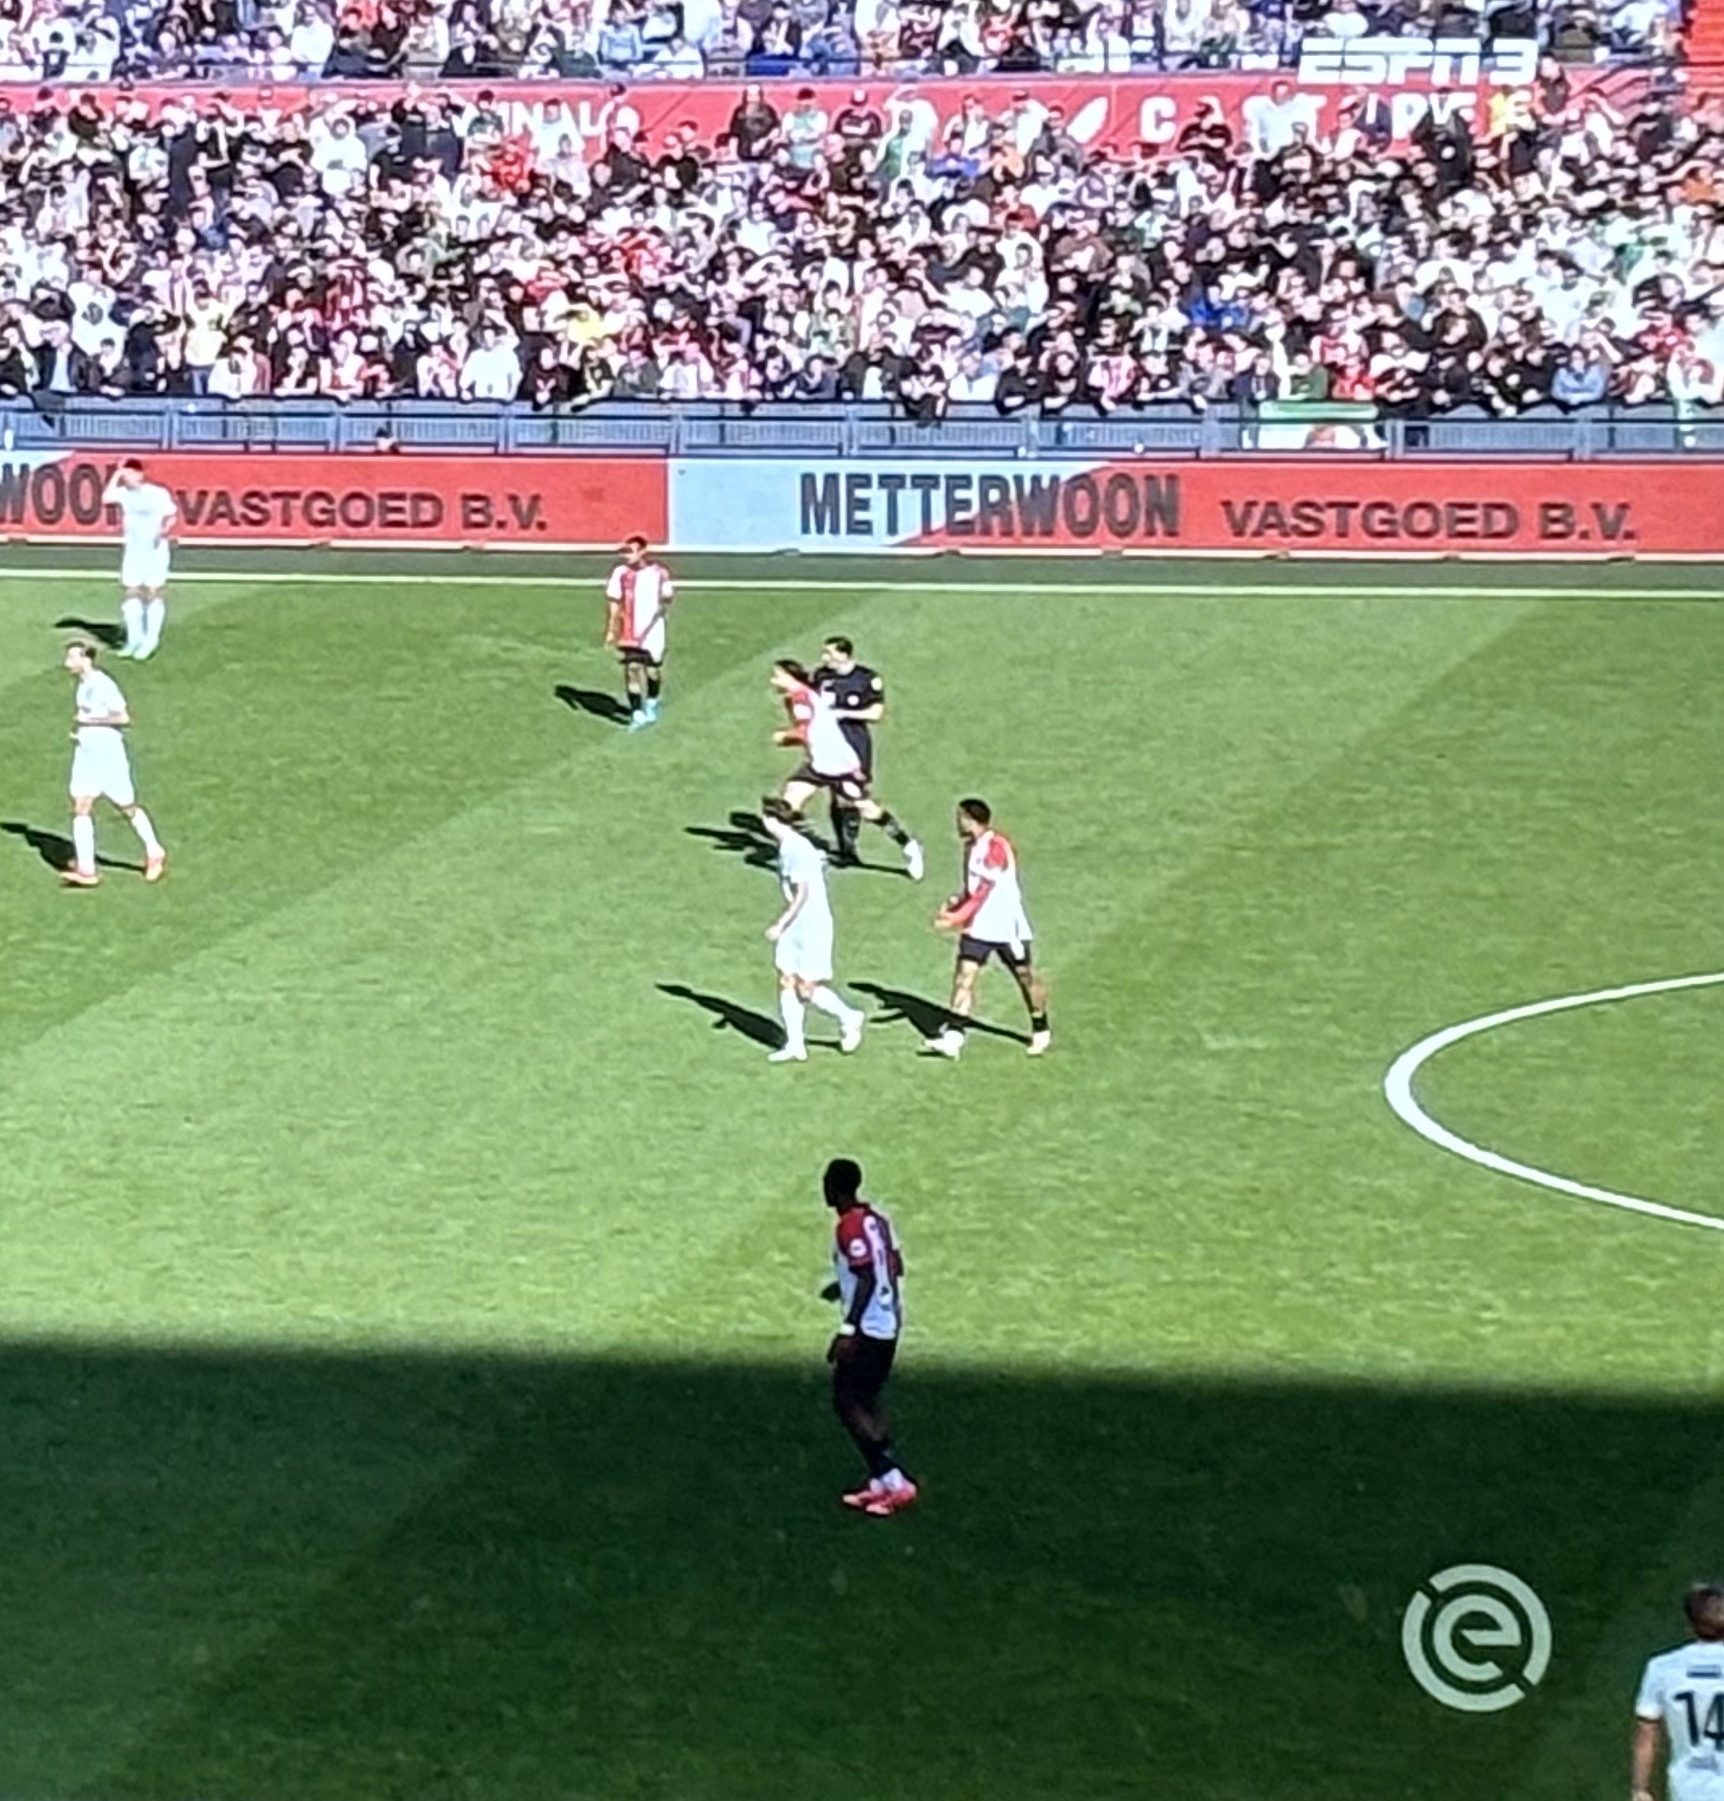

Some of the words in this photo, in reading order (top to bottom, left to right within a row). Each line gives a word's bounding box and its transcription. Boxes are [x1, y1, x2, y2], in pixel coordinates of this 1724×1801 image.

[175, 489, 444, 530] VASTGOED
[460, 493, 548, 531] B.V.
[800, 472, 1181, 538] METTERWOON
[1221, 499, 1520, 540] VASTGOED
[1538, 502, 1637, 541] B.V.
